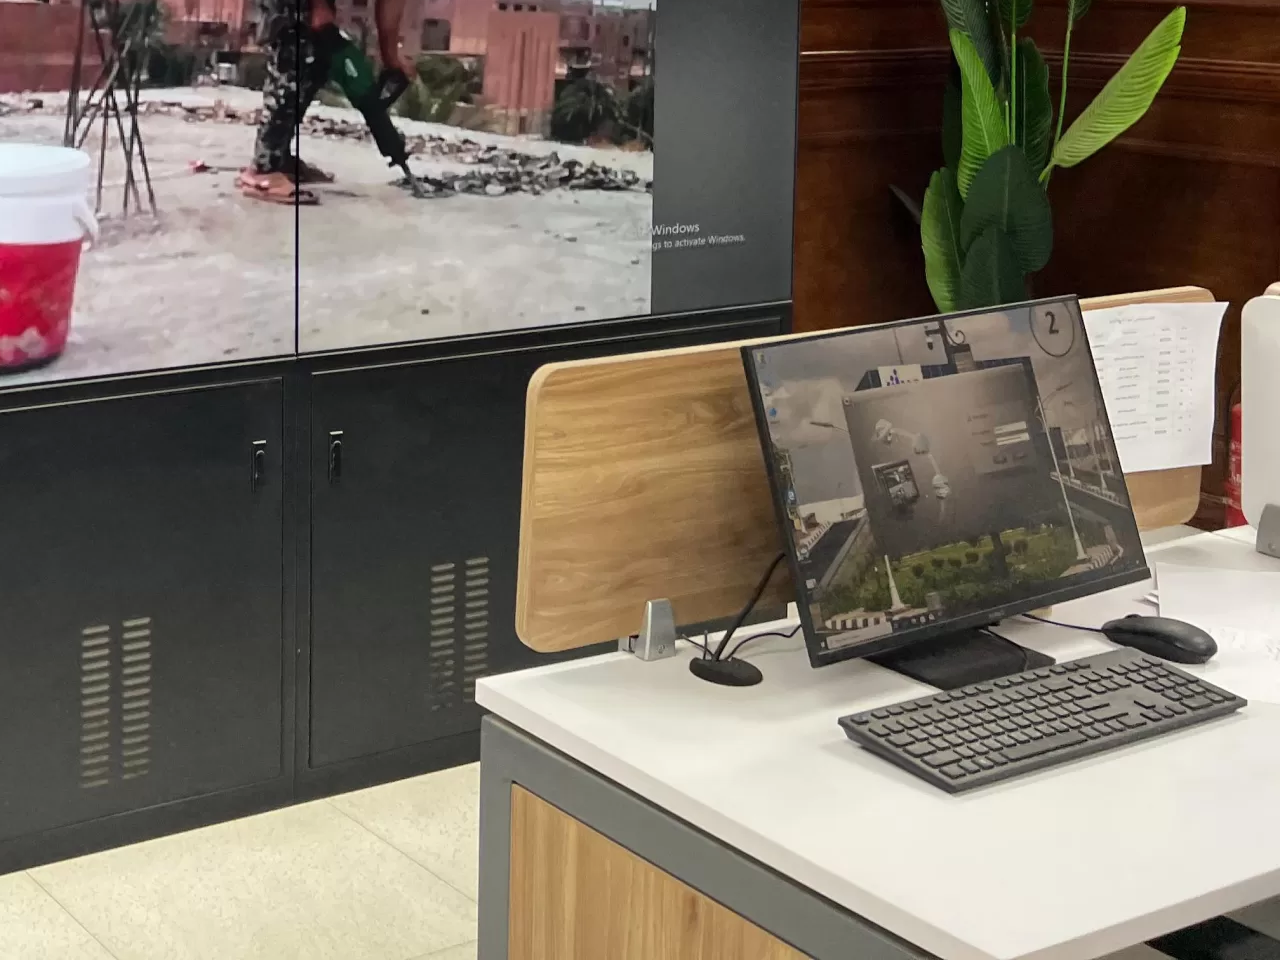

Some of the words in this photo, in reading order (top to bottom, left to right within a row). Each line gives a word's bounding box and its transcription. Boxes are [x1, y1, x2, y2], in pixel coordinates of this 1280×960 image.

[650, 223, 700, 236] Windows
[663, 240, 673, 248] to
[674, 237, 706, 247] activate
[1045, 311, 1060, 335] 2
